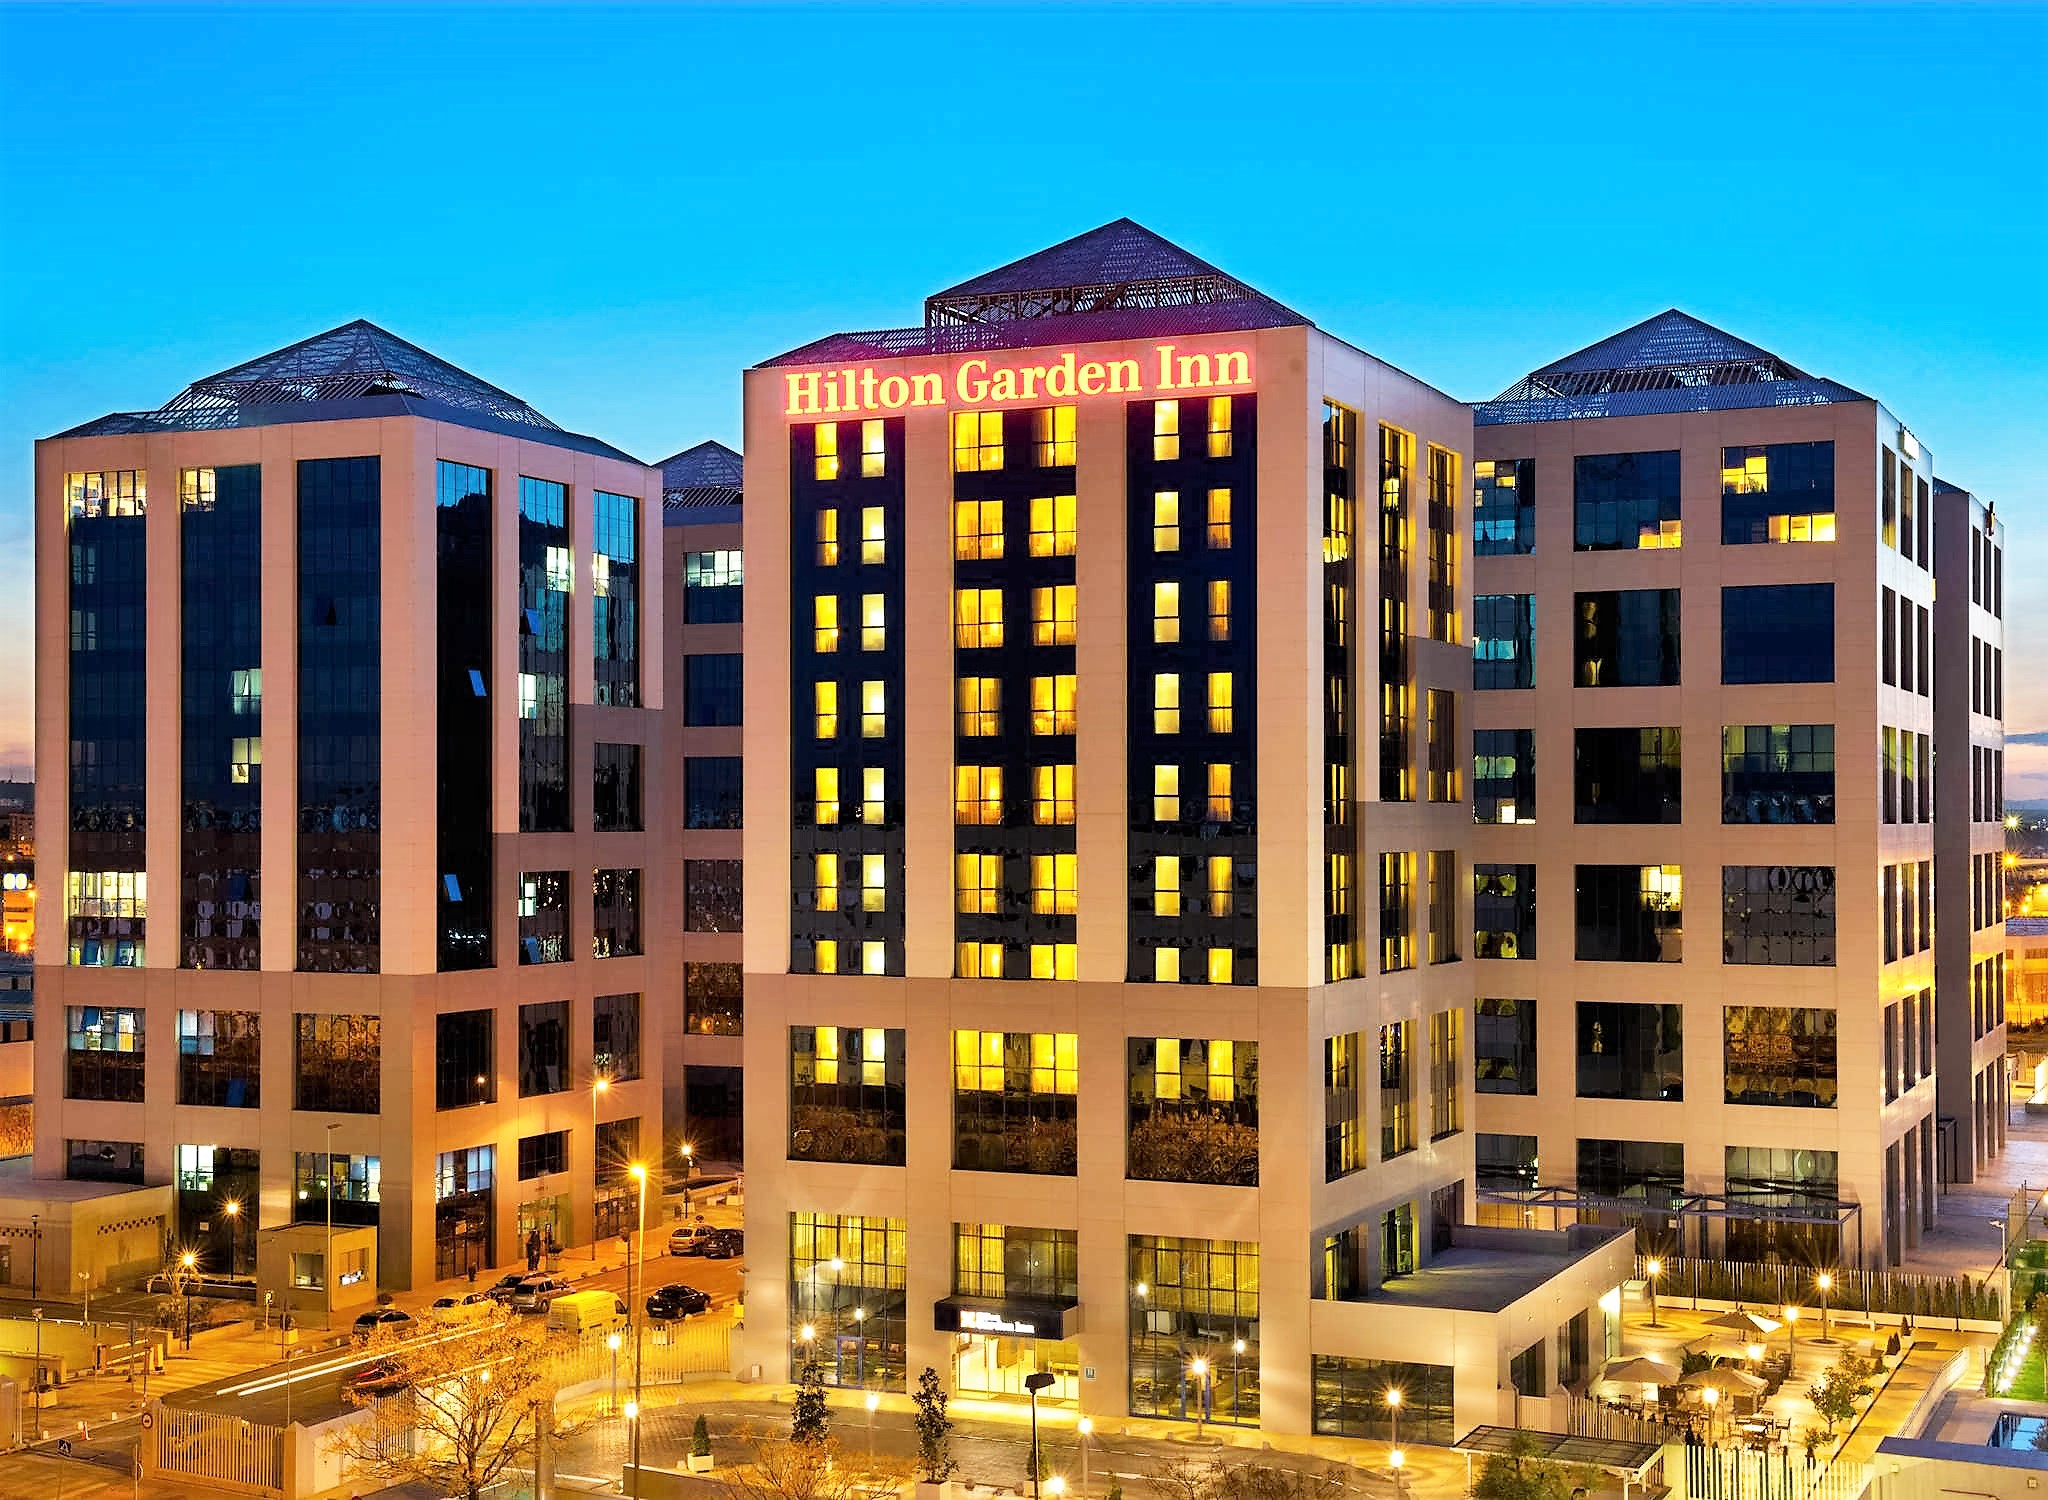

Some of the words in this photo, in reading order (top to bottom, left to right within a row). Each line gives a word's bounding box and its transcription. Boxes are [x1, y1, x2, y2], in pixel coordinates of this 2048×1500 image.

[785, 367, 946, 415] Hilton
[956, 353, 1143, 403] Garden
[1156, 345, 1252, 389] Inn
